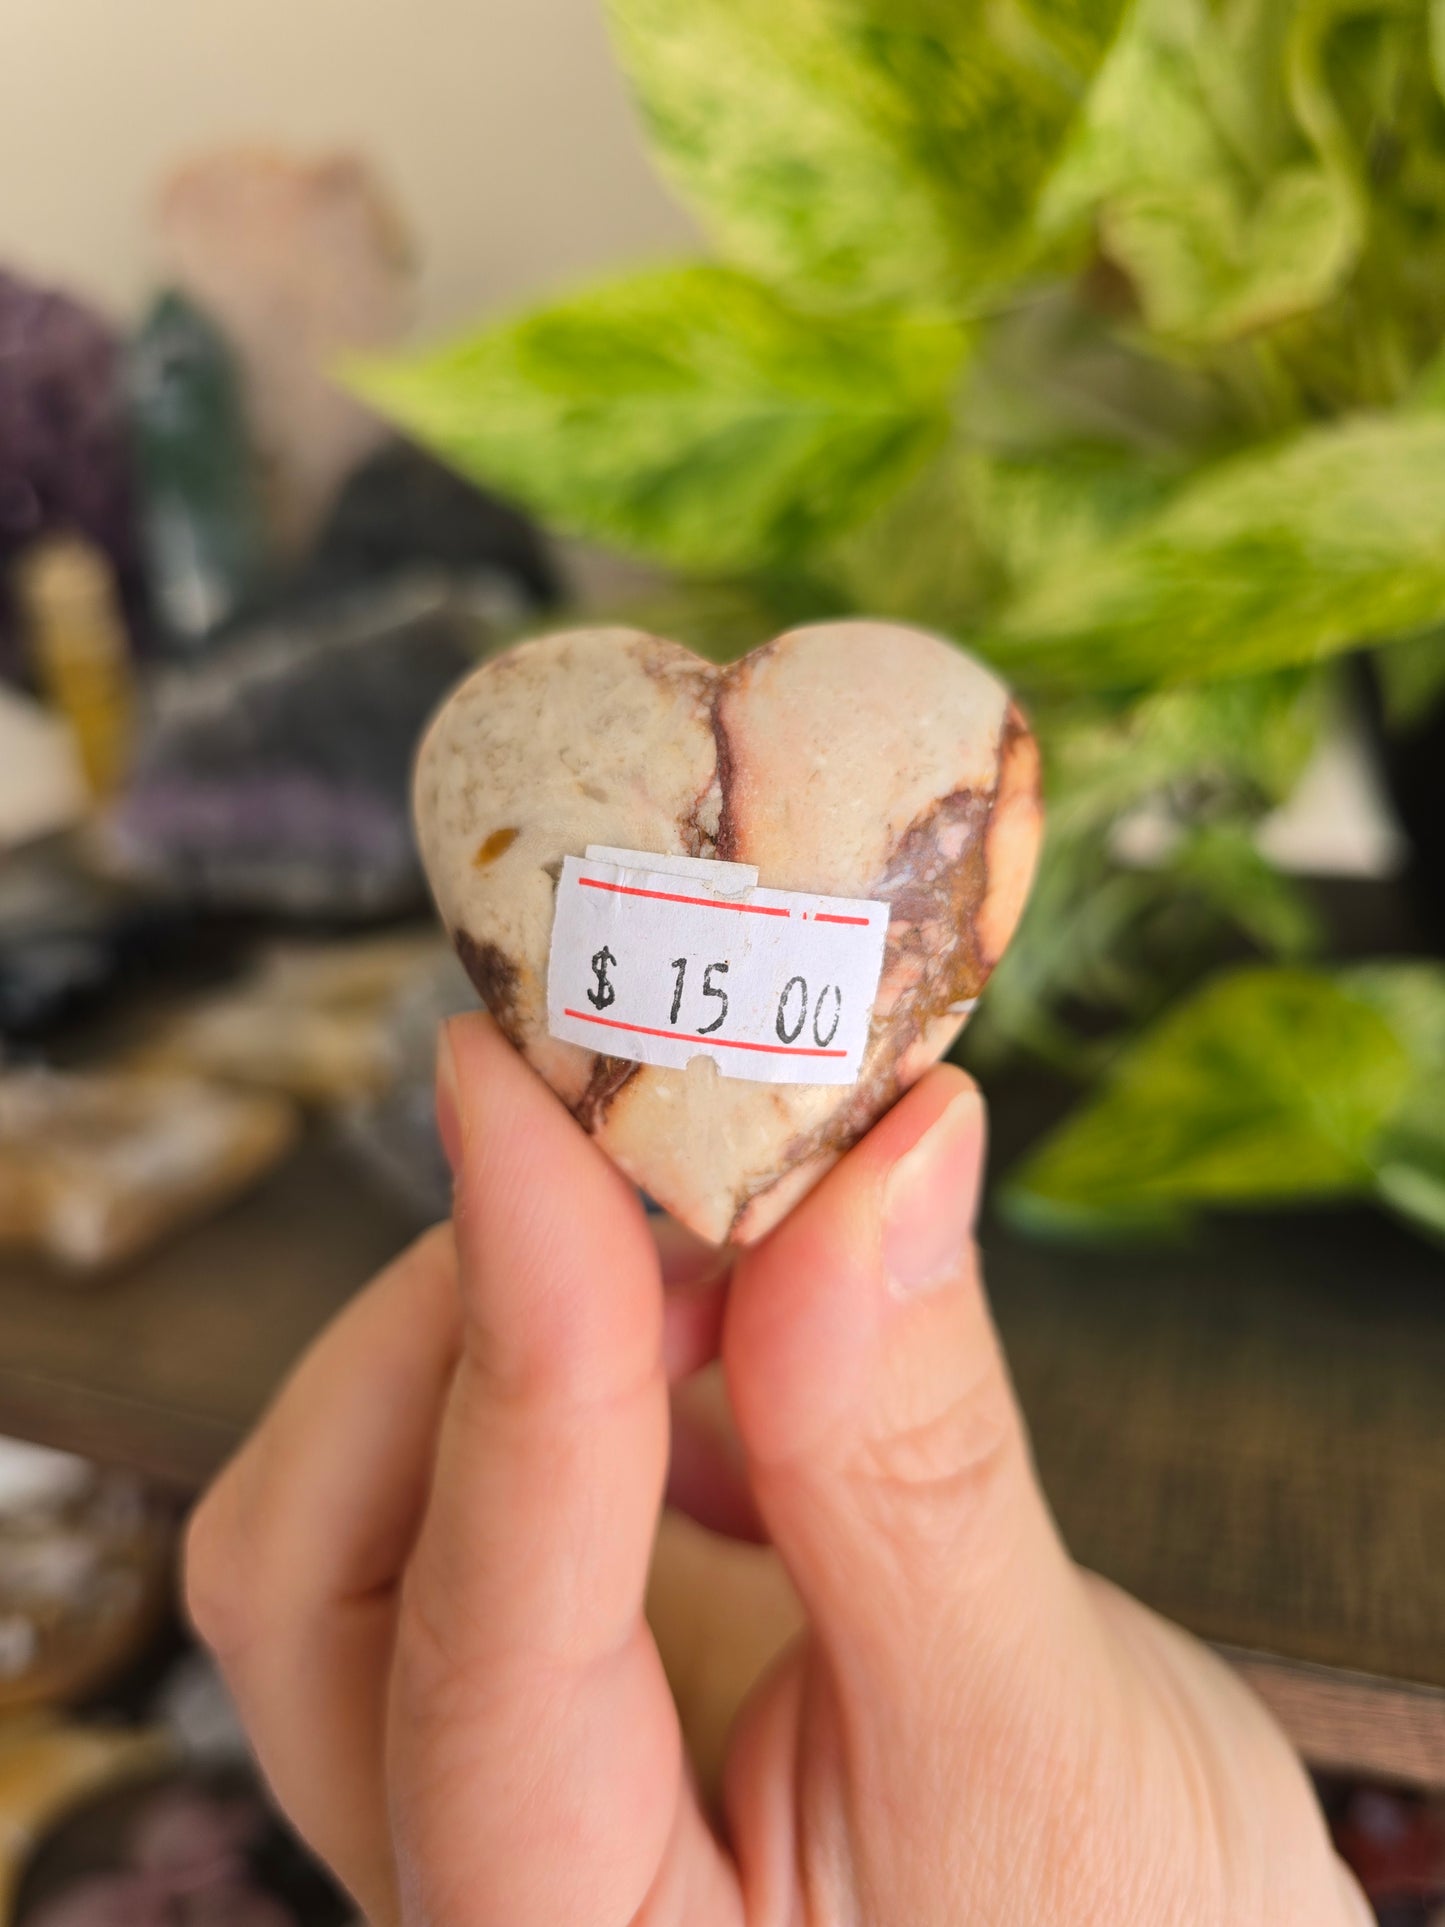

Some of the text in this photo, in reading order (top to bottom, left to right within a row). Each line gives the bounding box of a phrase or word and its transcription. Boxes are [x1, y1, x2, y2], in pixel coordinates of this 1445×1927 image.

[586, 945, 842, 1048] $ 15 00
